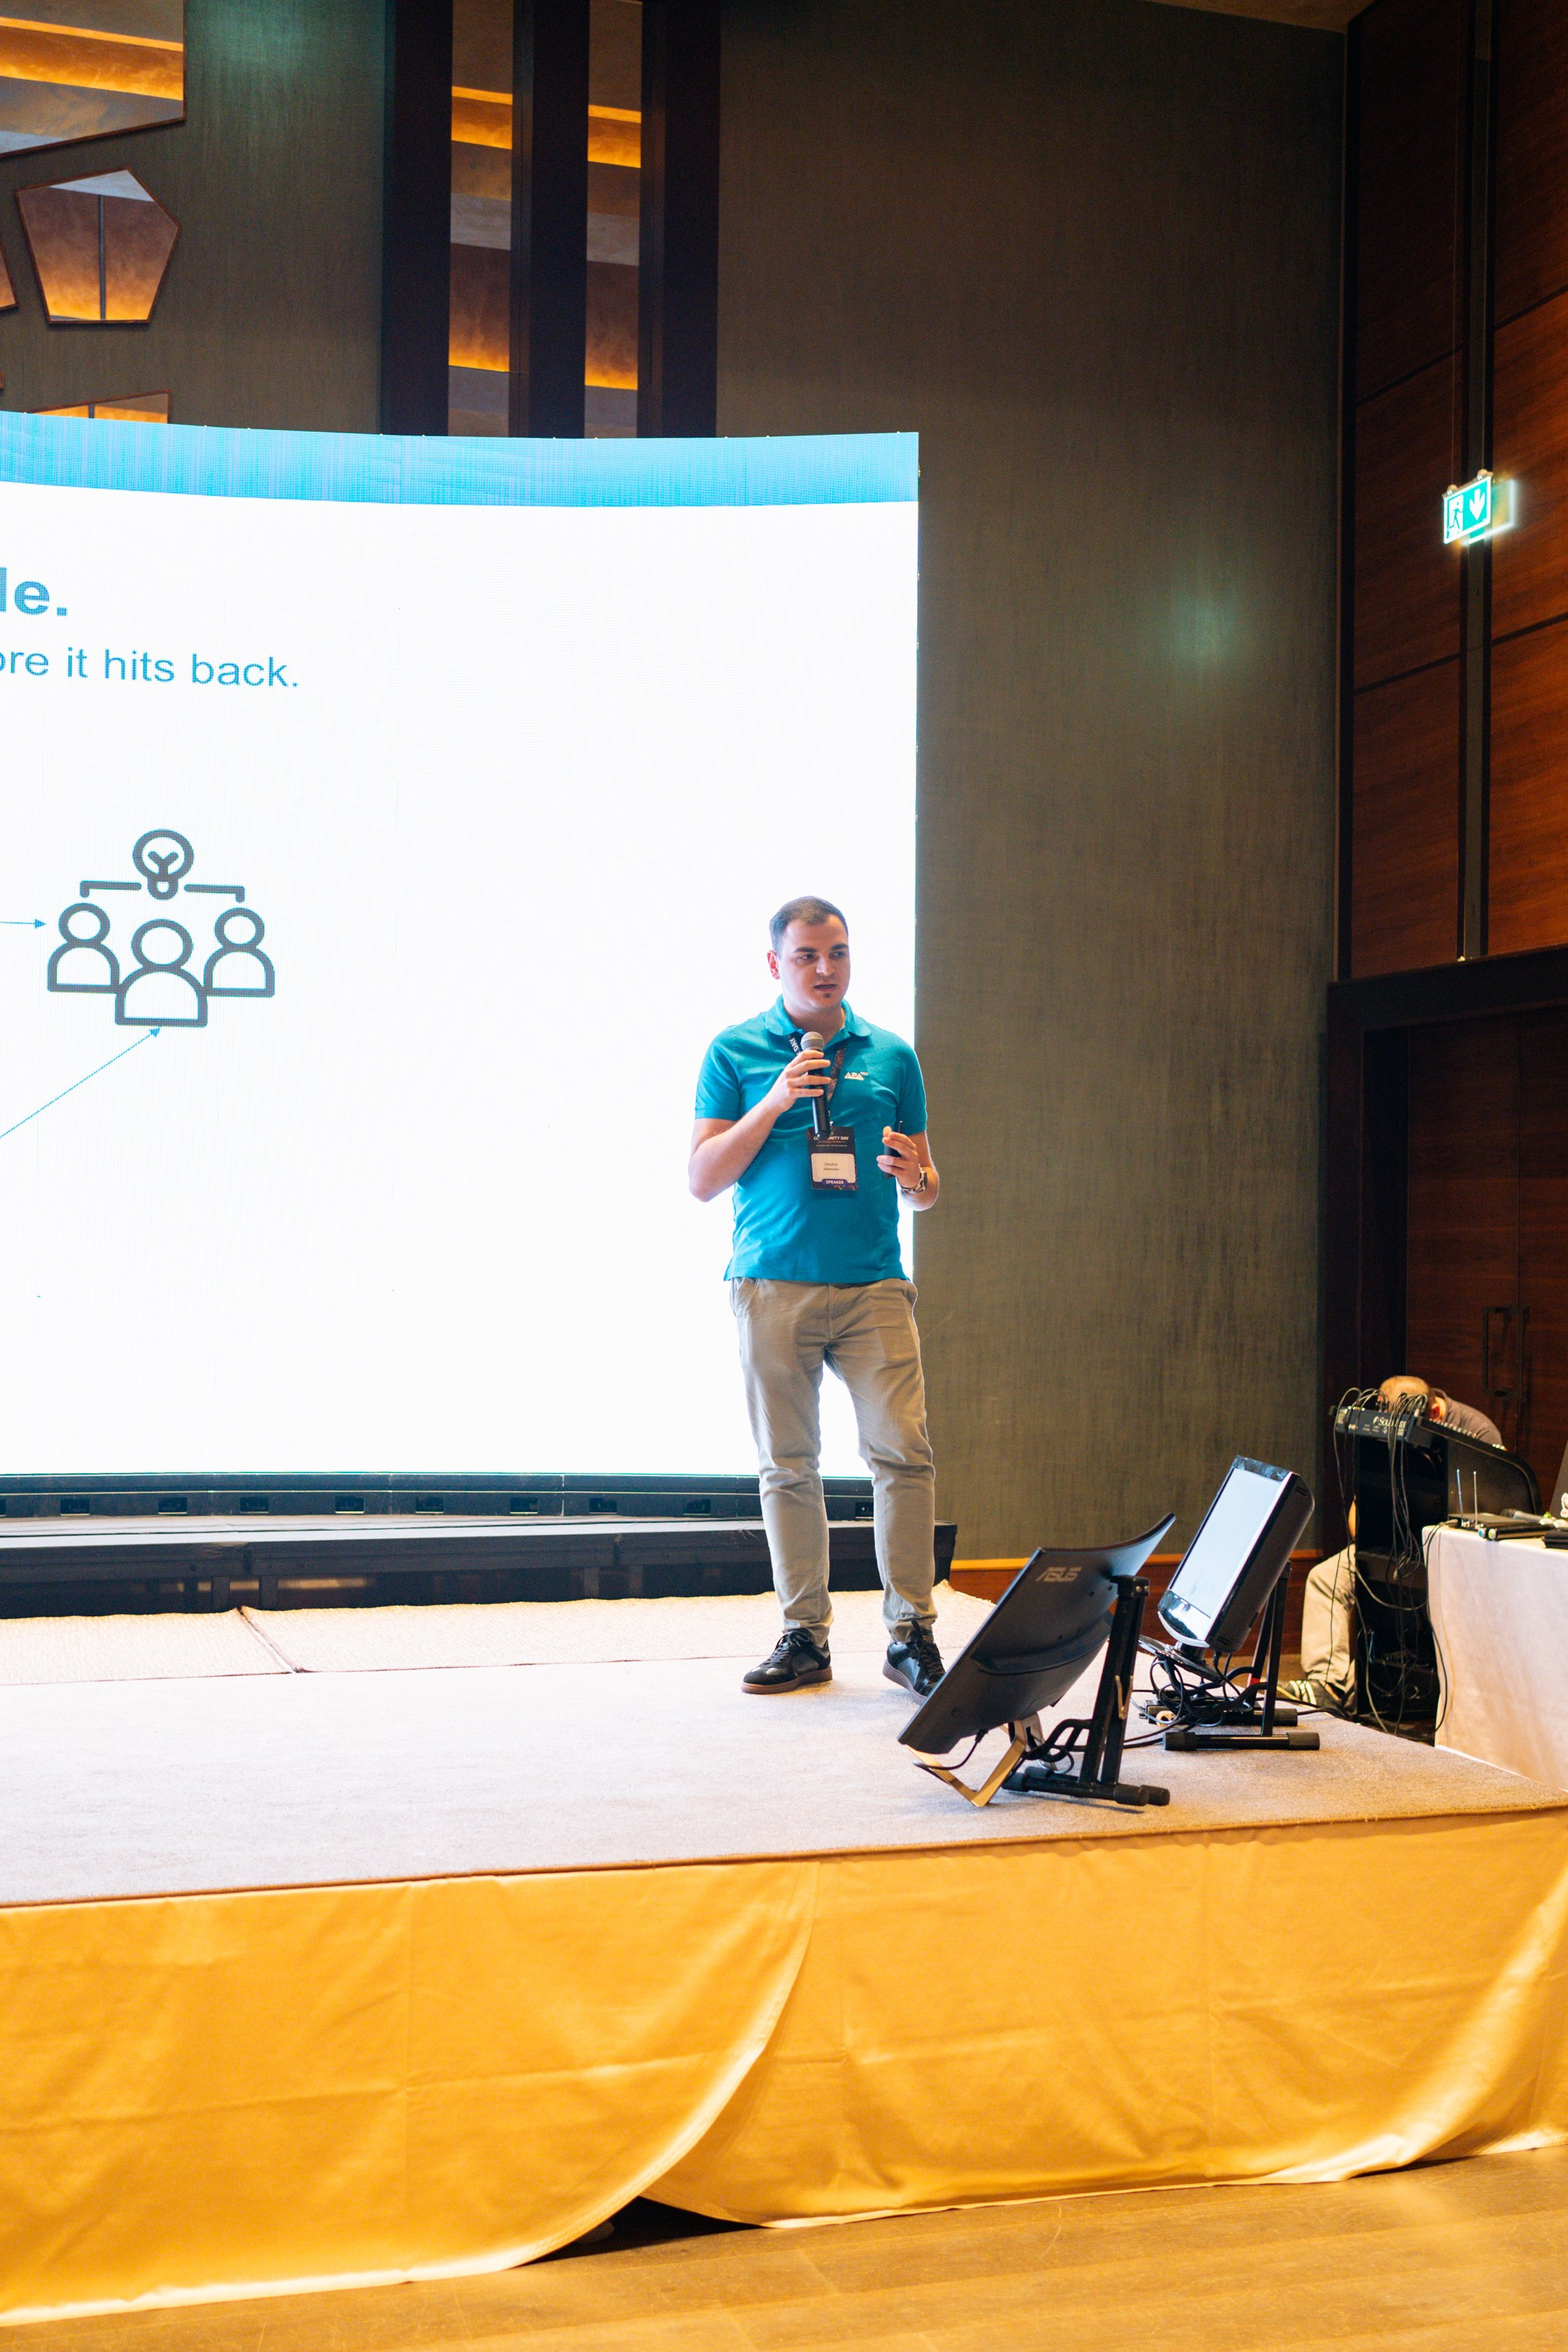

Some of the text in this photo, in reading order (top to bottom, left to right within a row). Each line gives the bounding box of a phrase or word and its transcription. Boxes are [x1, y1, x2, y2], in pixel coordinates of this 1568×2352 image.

[0, 646, 299, 688] re it hits back.
[789, 1038, 799, 1052] DAY
[1035, 1566, 1083, 1583] ASUS
